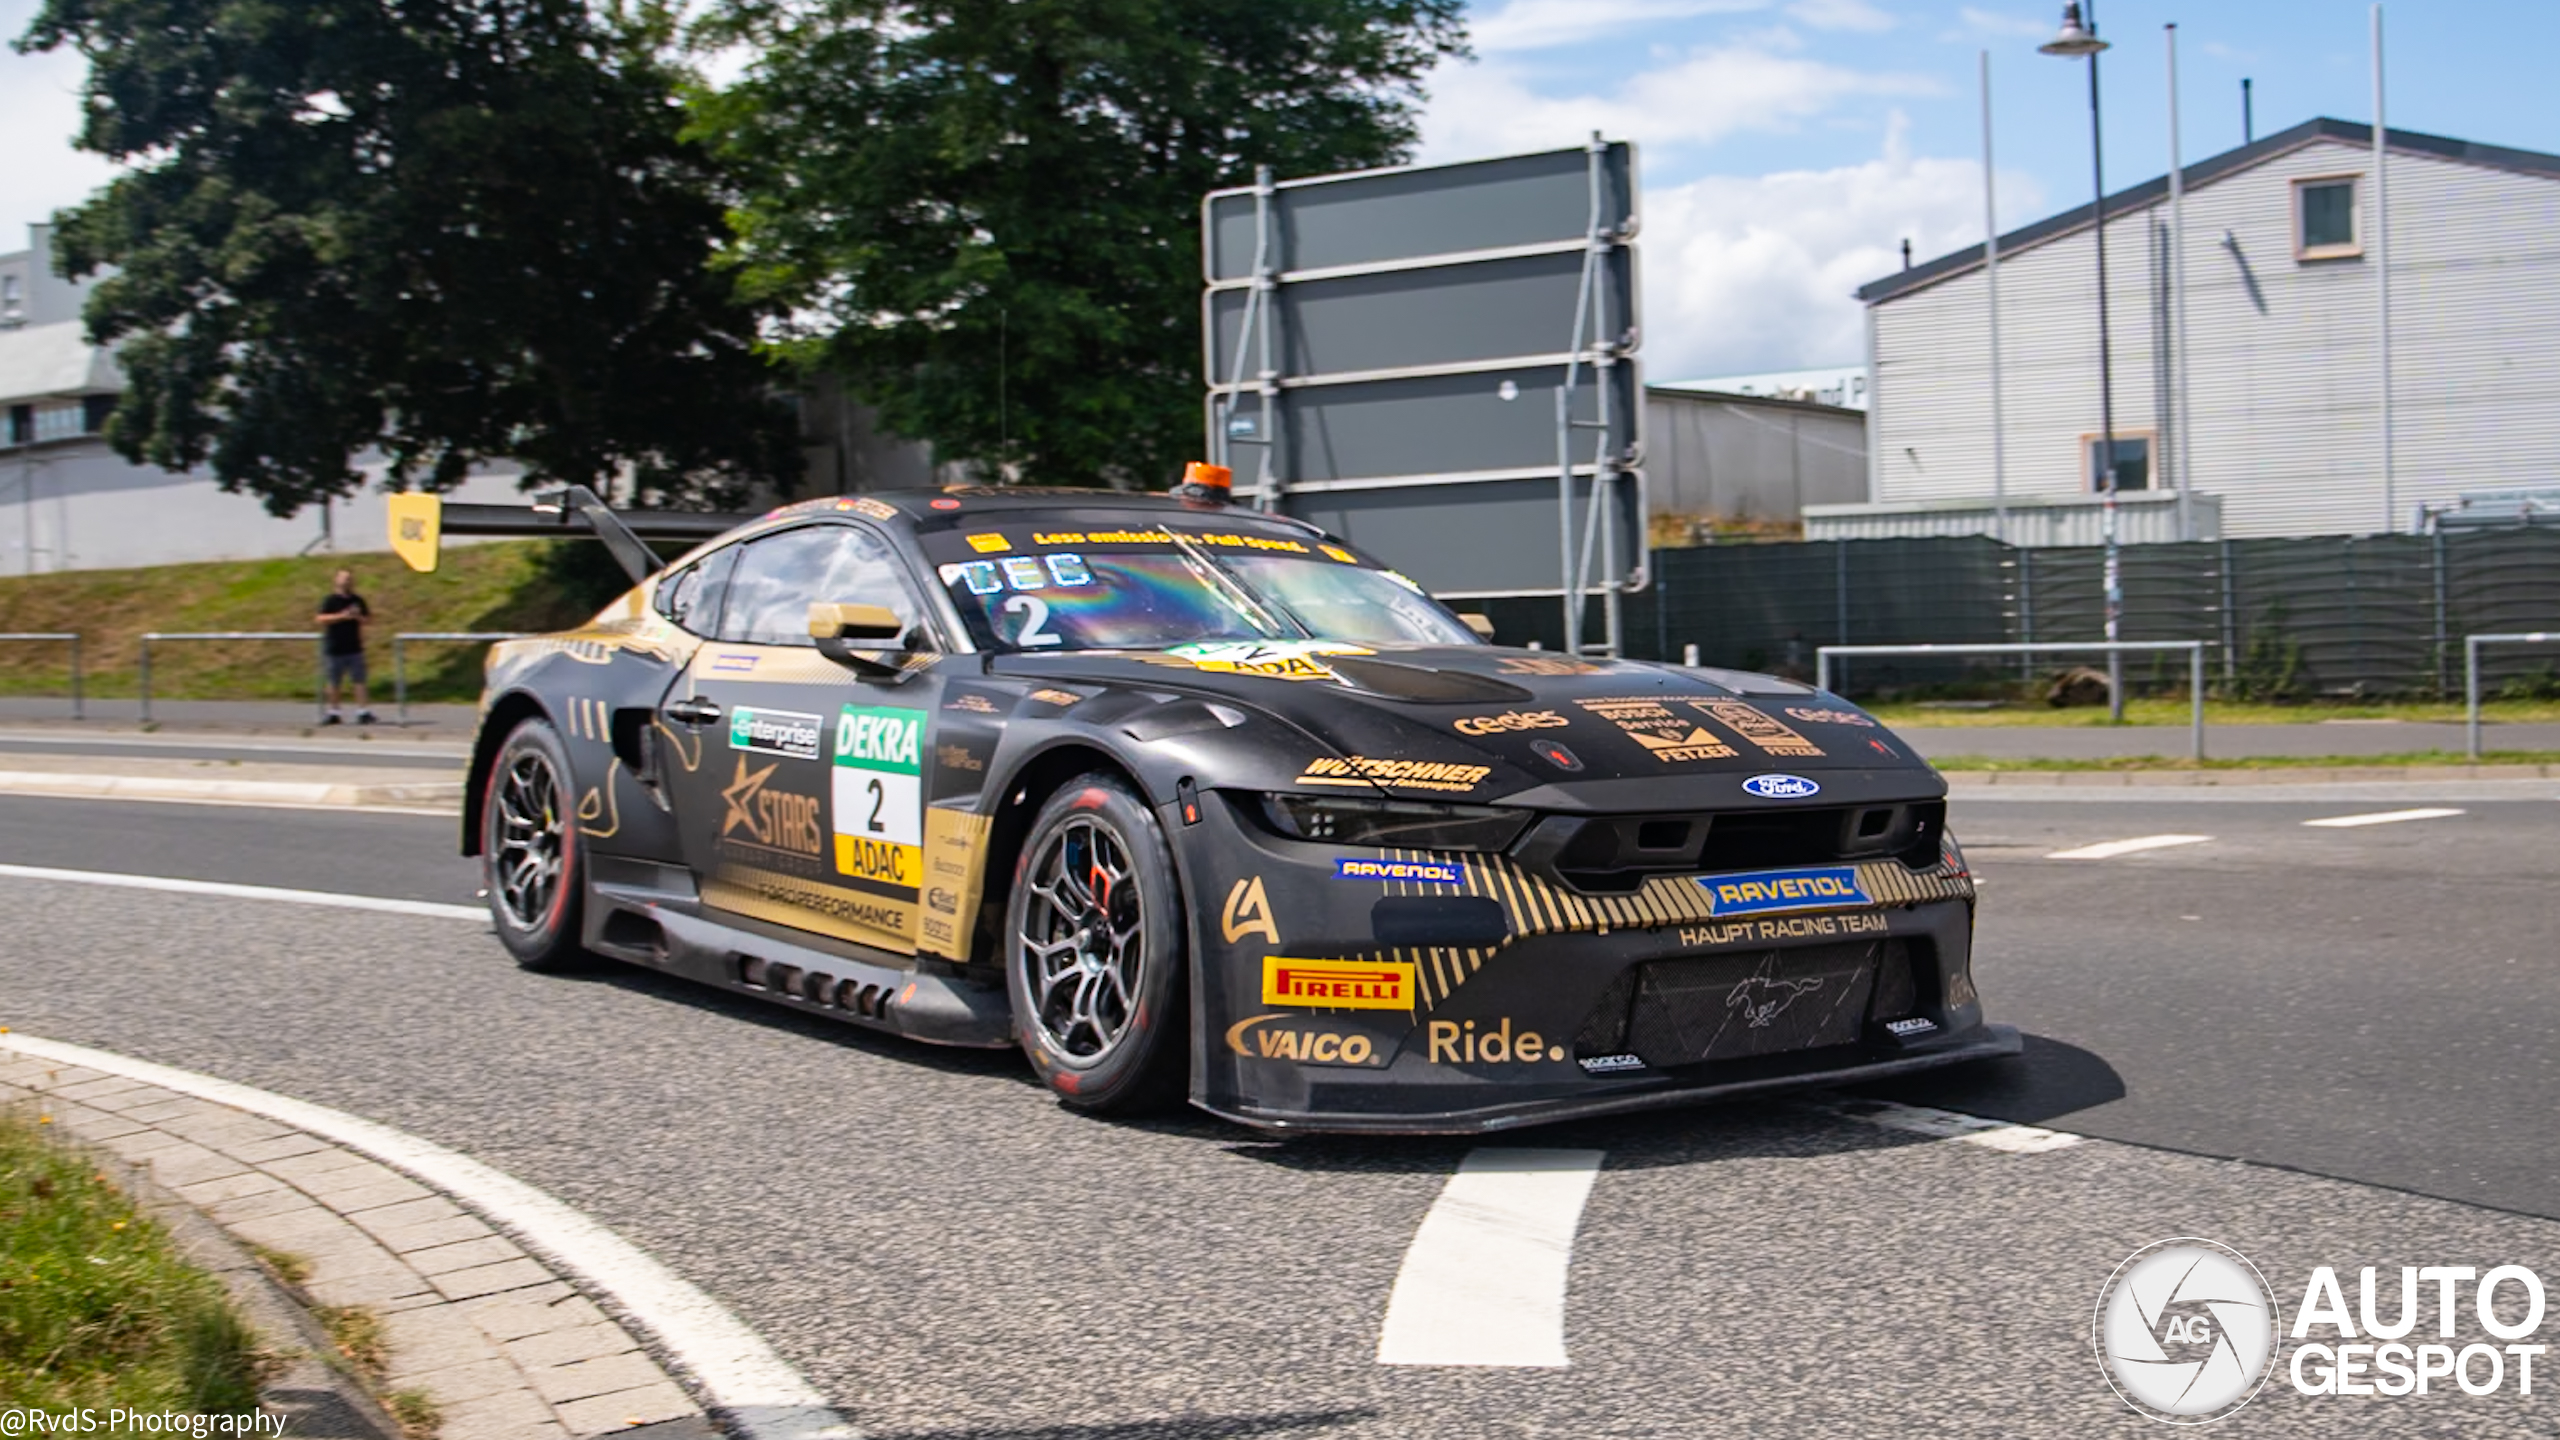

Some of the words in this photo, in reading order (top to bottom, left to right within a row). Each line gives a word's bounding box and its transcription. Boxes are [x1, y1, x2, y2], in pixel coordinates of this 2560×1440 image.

[1033, 532, 1086, 545] Less
[1004, 595, 1063, 646] 2
[732, 717, 818, 748] enterprise
[835, 712, 920, 766] DEKRA
[1652, 744, 1740, 763] FETZER
[1763, 745, 1827, 756] FETZER
[1304, 755, 1492, 784] WÜTSCHNER
[1758, 777, 1808, 795] Ford
[758, 788, 822, 854] STARS
[867, 778, 885, 833] 2
[853, 839, 905, 882] ADAC
[1342, 861, 1457, 881] RAVENOL
[1718, 876, 1855, 904] RAVENOL
[1679, 921, 1755, 946] HAUPT
[1758, 915, 1836, 940] RACING
[1837, 914, 1889, 933] TEAM
[1276, 967, 1402, 1000] PIRELLI
[1257, 1029, 1373, 1065] VAICO
[1428, 1017, 1566, 1065] Ride.
